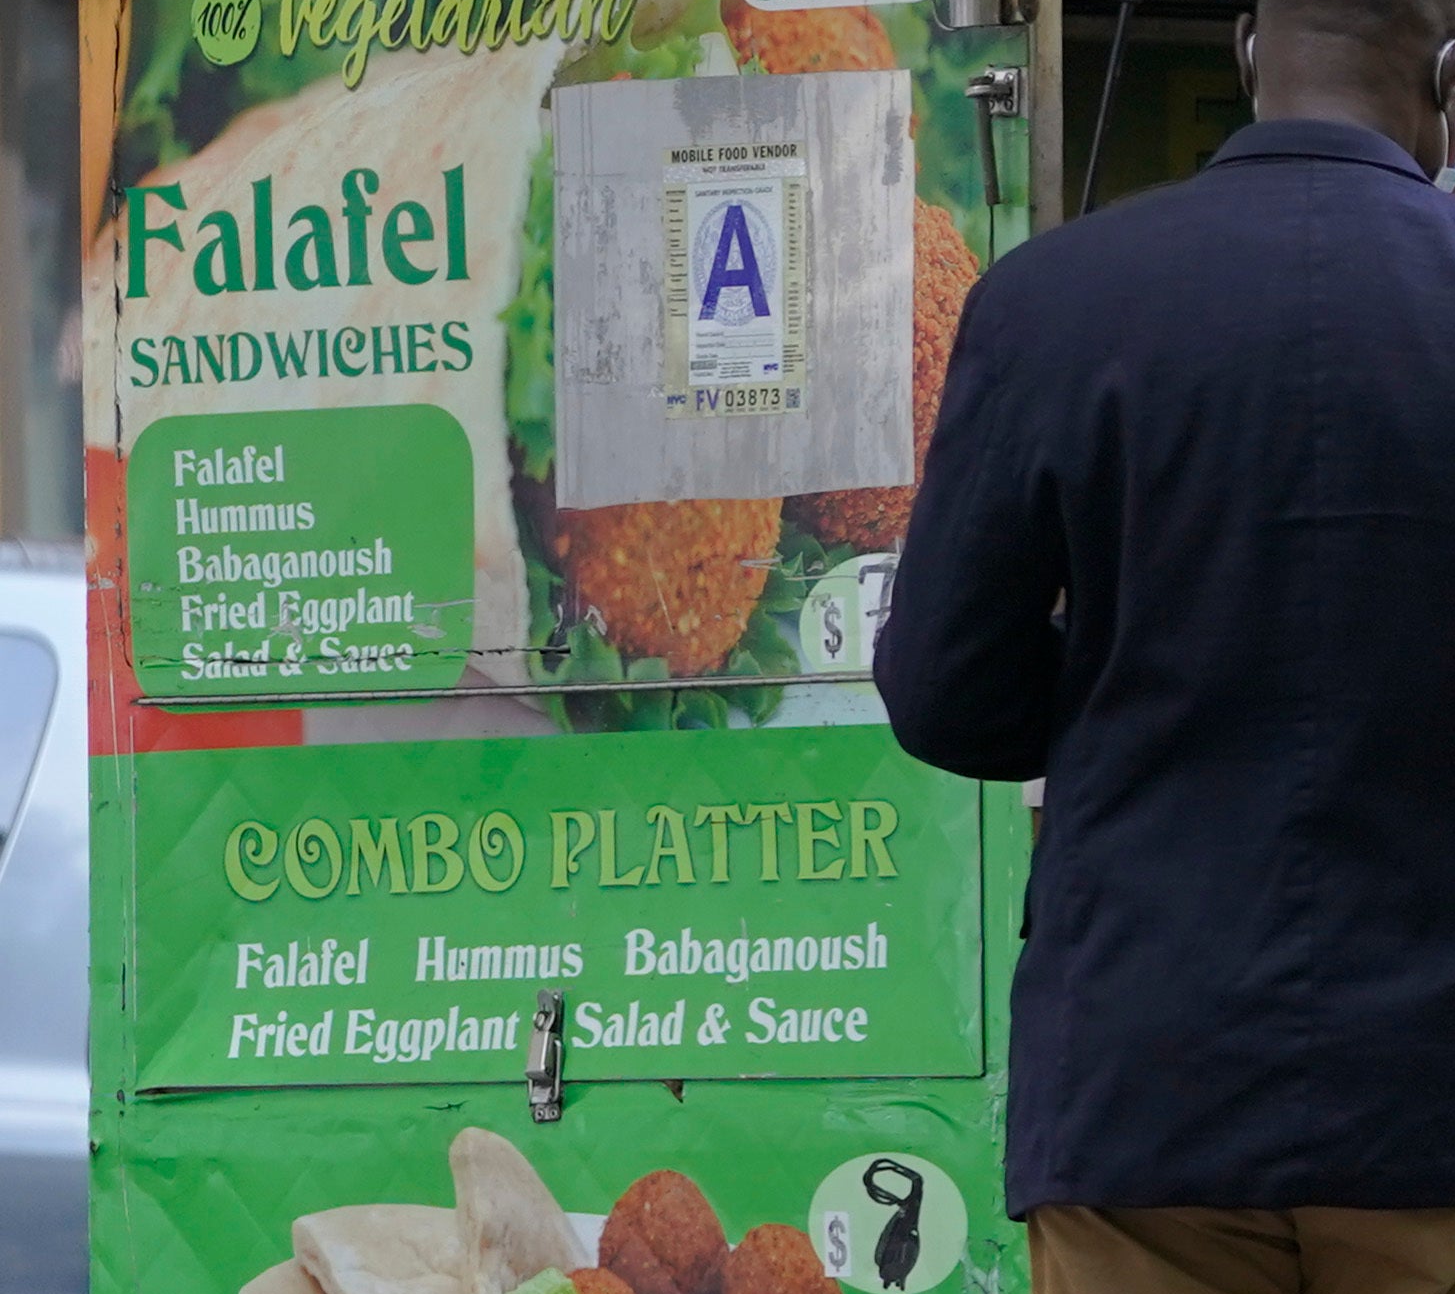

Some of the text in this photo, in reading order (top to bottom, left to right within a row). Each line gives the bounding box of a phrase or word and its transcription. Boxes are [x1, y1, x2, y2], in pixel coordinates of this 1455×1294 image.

[197, 0, 256, 42] 100%
[671, 144, 798, 164] MOBILE FOOD VENDOR
[124, 163, 471, 299] Falafel
[698, 205, 771, 321] A
[130, 320, 474, 388] SANDWICHES
[696, 389, 720, 411] FV
[724, 388, 781, 407] 03873
[173, 444, 285, 487] Falafel
[175, 498, 316, 535] Hummus
[176, 537, 392, 588] Babaganoush
[180, 587, 415, 634] Fried Eggplant
[180, 637, 415, 681] Salad & Sauce
[223, 800, 900, 902] COMBO PLATTER
[235, 922, 889, 991] Falafel Hummus Babaganoush
[227, 996, 869, 1064] Fried Eggplant Salad & Sauce
